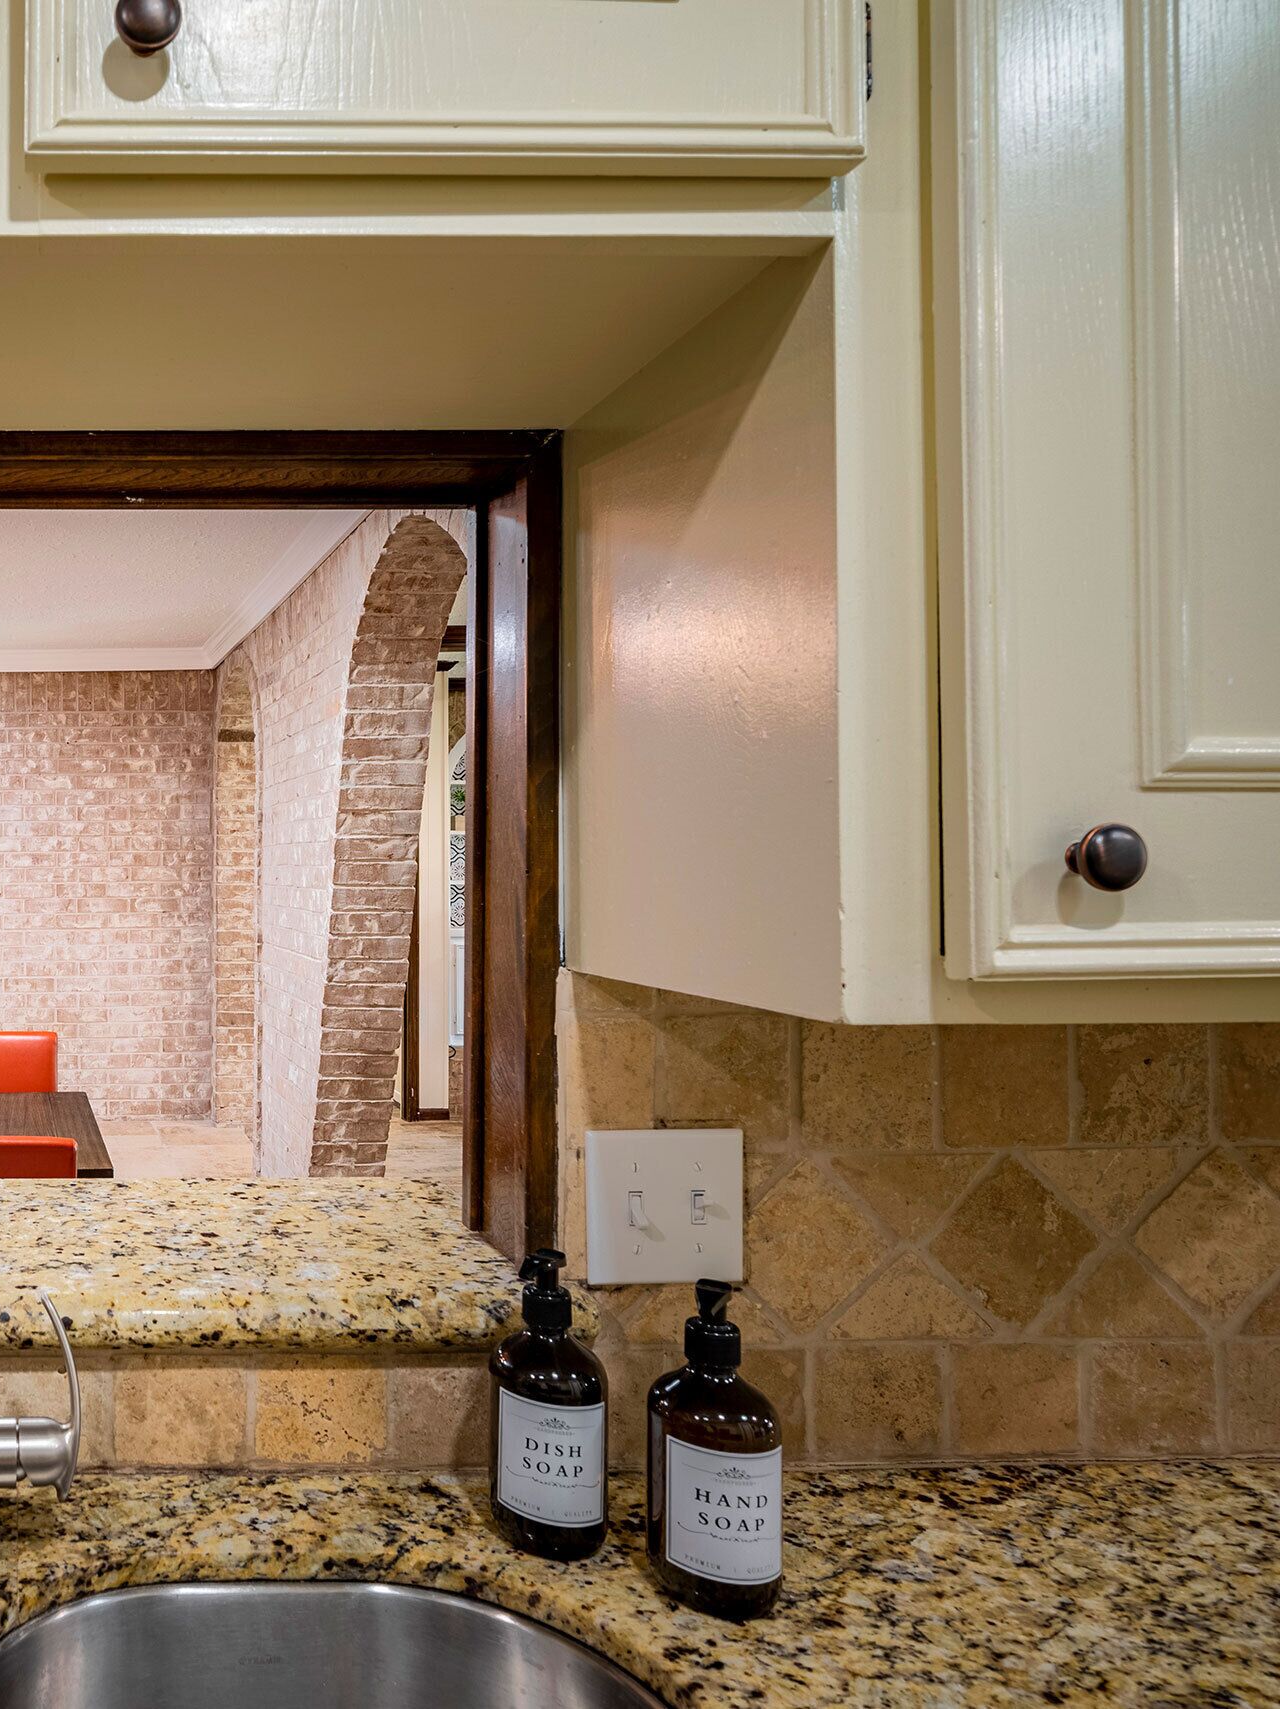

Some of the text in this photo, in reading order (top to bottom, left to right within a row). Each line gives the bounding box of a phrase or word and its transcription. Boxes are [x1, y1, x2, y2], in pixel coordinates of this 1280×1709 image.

[524, 1437, 582, 1458] DISH
[522, 1457, 583, 1477] SOAP
[510, 1495, 541, 1511] PREMIUM
[694, 1487, 768, 1509] HAND
[698, 1512, 765, 1532] SOAP
[684, 1553, 721, 1570] PREMIUM
